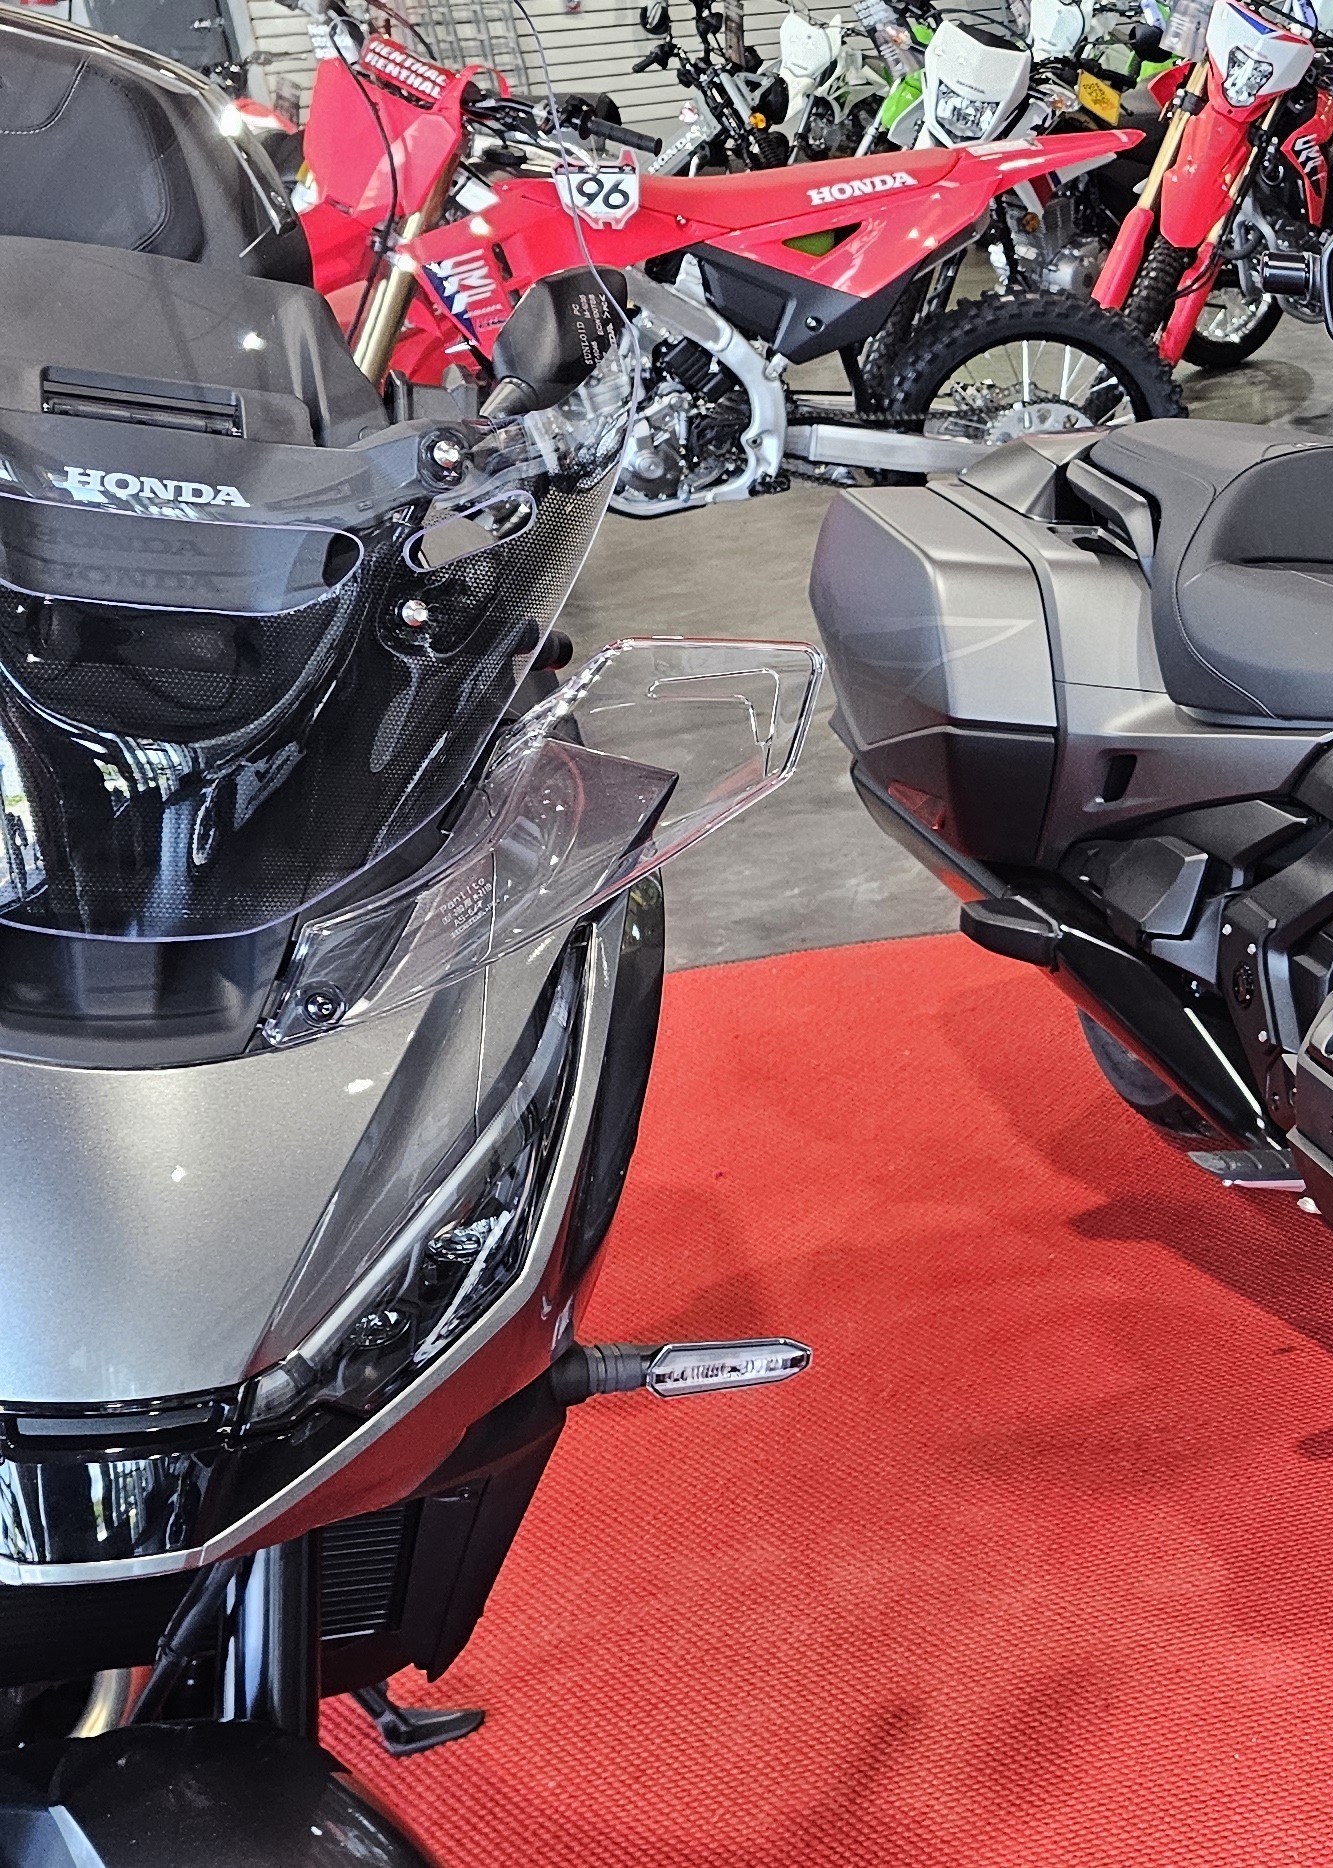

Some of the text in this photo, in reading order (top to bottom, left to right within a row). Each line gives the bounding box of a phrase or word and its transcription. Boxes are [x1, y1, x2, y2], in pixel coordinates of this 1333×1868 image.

[368, 40, 449, 87] RENTHAL
[648, 124, 709, 175] HONDA
[575, 176, 630, 210] 96
[806, 171, 918, 205] HONDA
[576, 321, 593, 365] SUNLOID
[63, 465, 251, 508] HONDA
